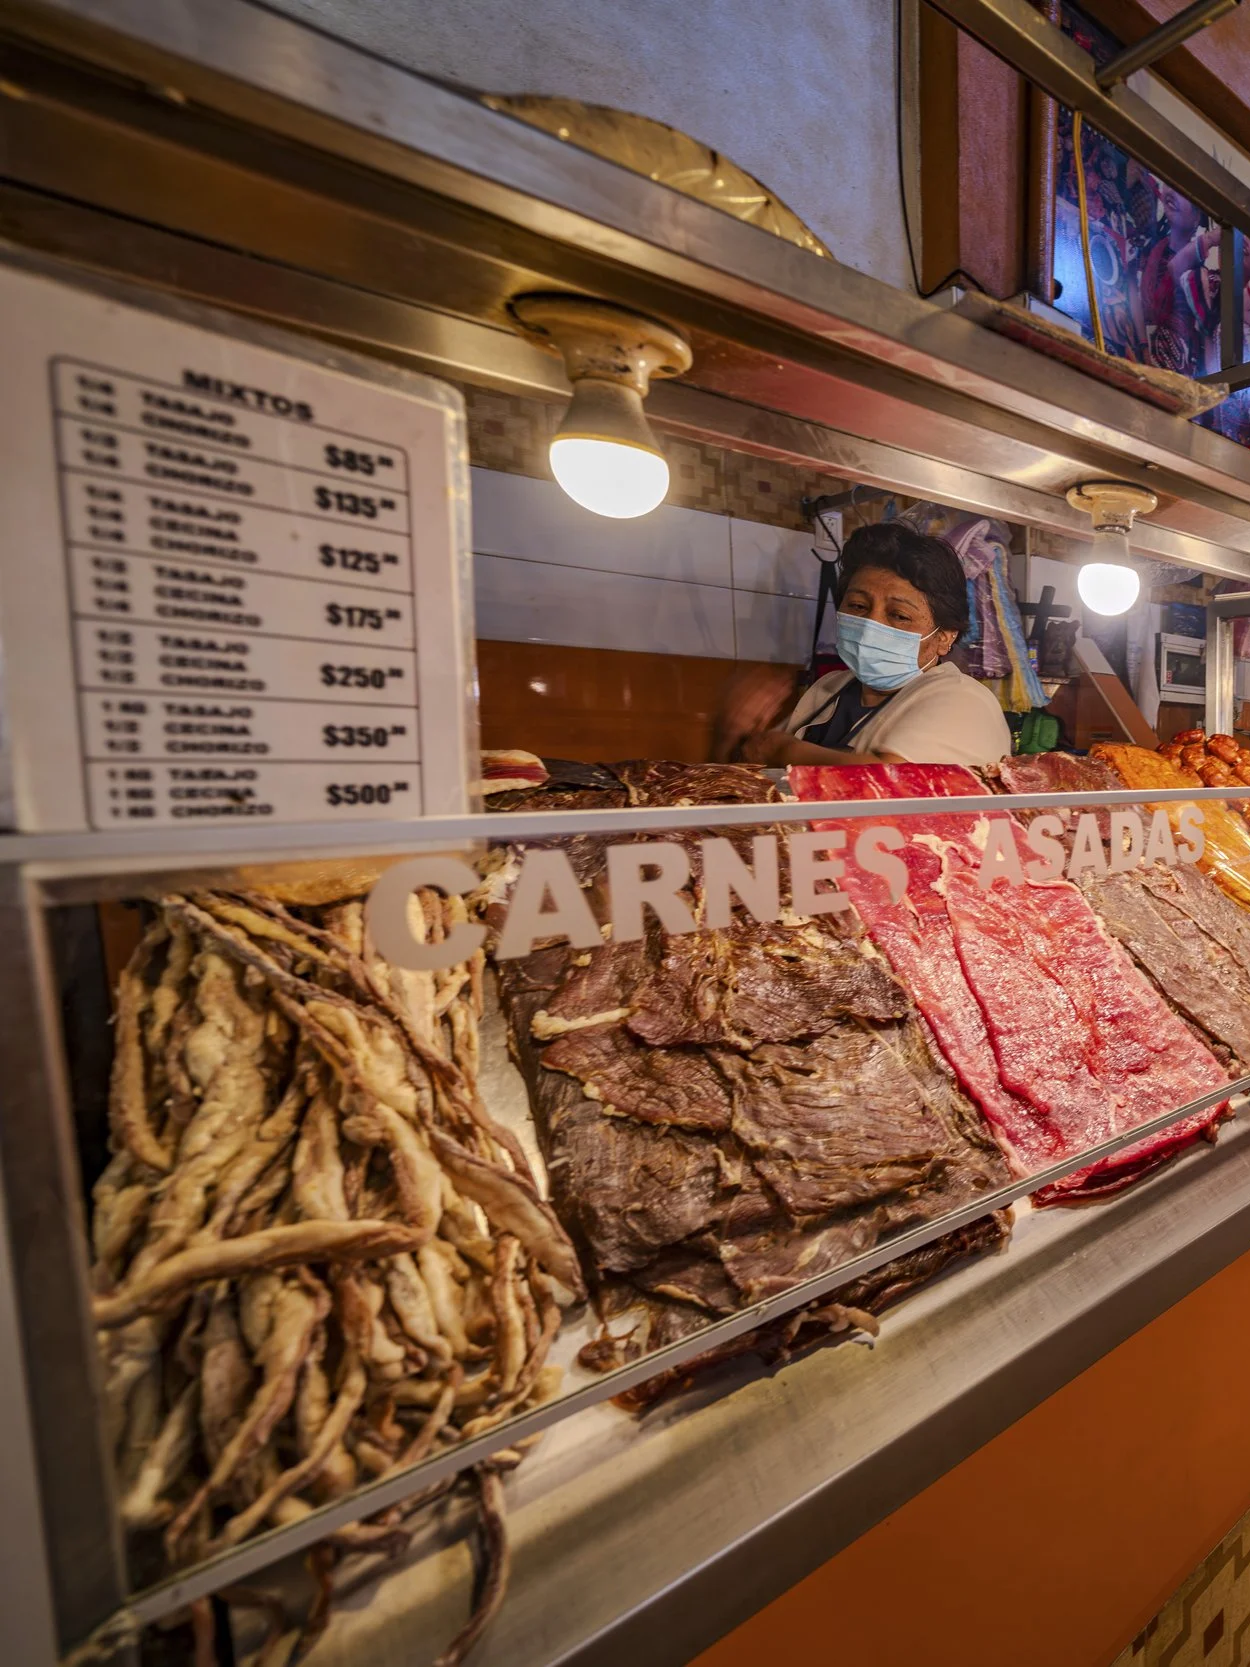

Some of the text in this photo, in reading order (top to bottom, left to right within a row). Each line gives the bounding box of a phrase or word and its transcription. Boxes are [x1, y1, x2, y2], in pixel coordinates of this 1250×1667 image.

[182, 369, 314, 421] MIXTOS
[363, 825, 910, 972] CARNES
[977, 807, 1206, 890] ASADAS
